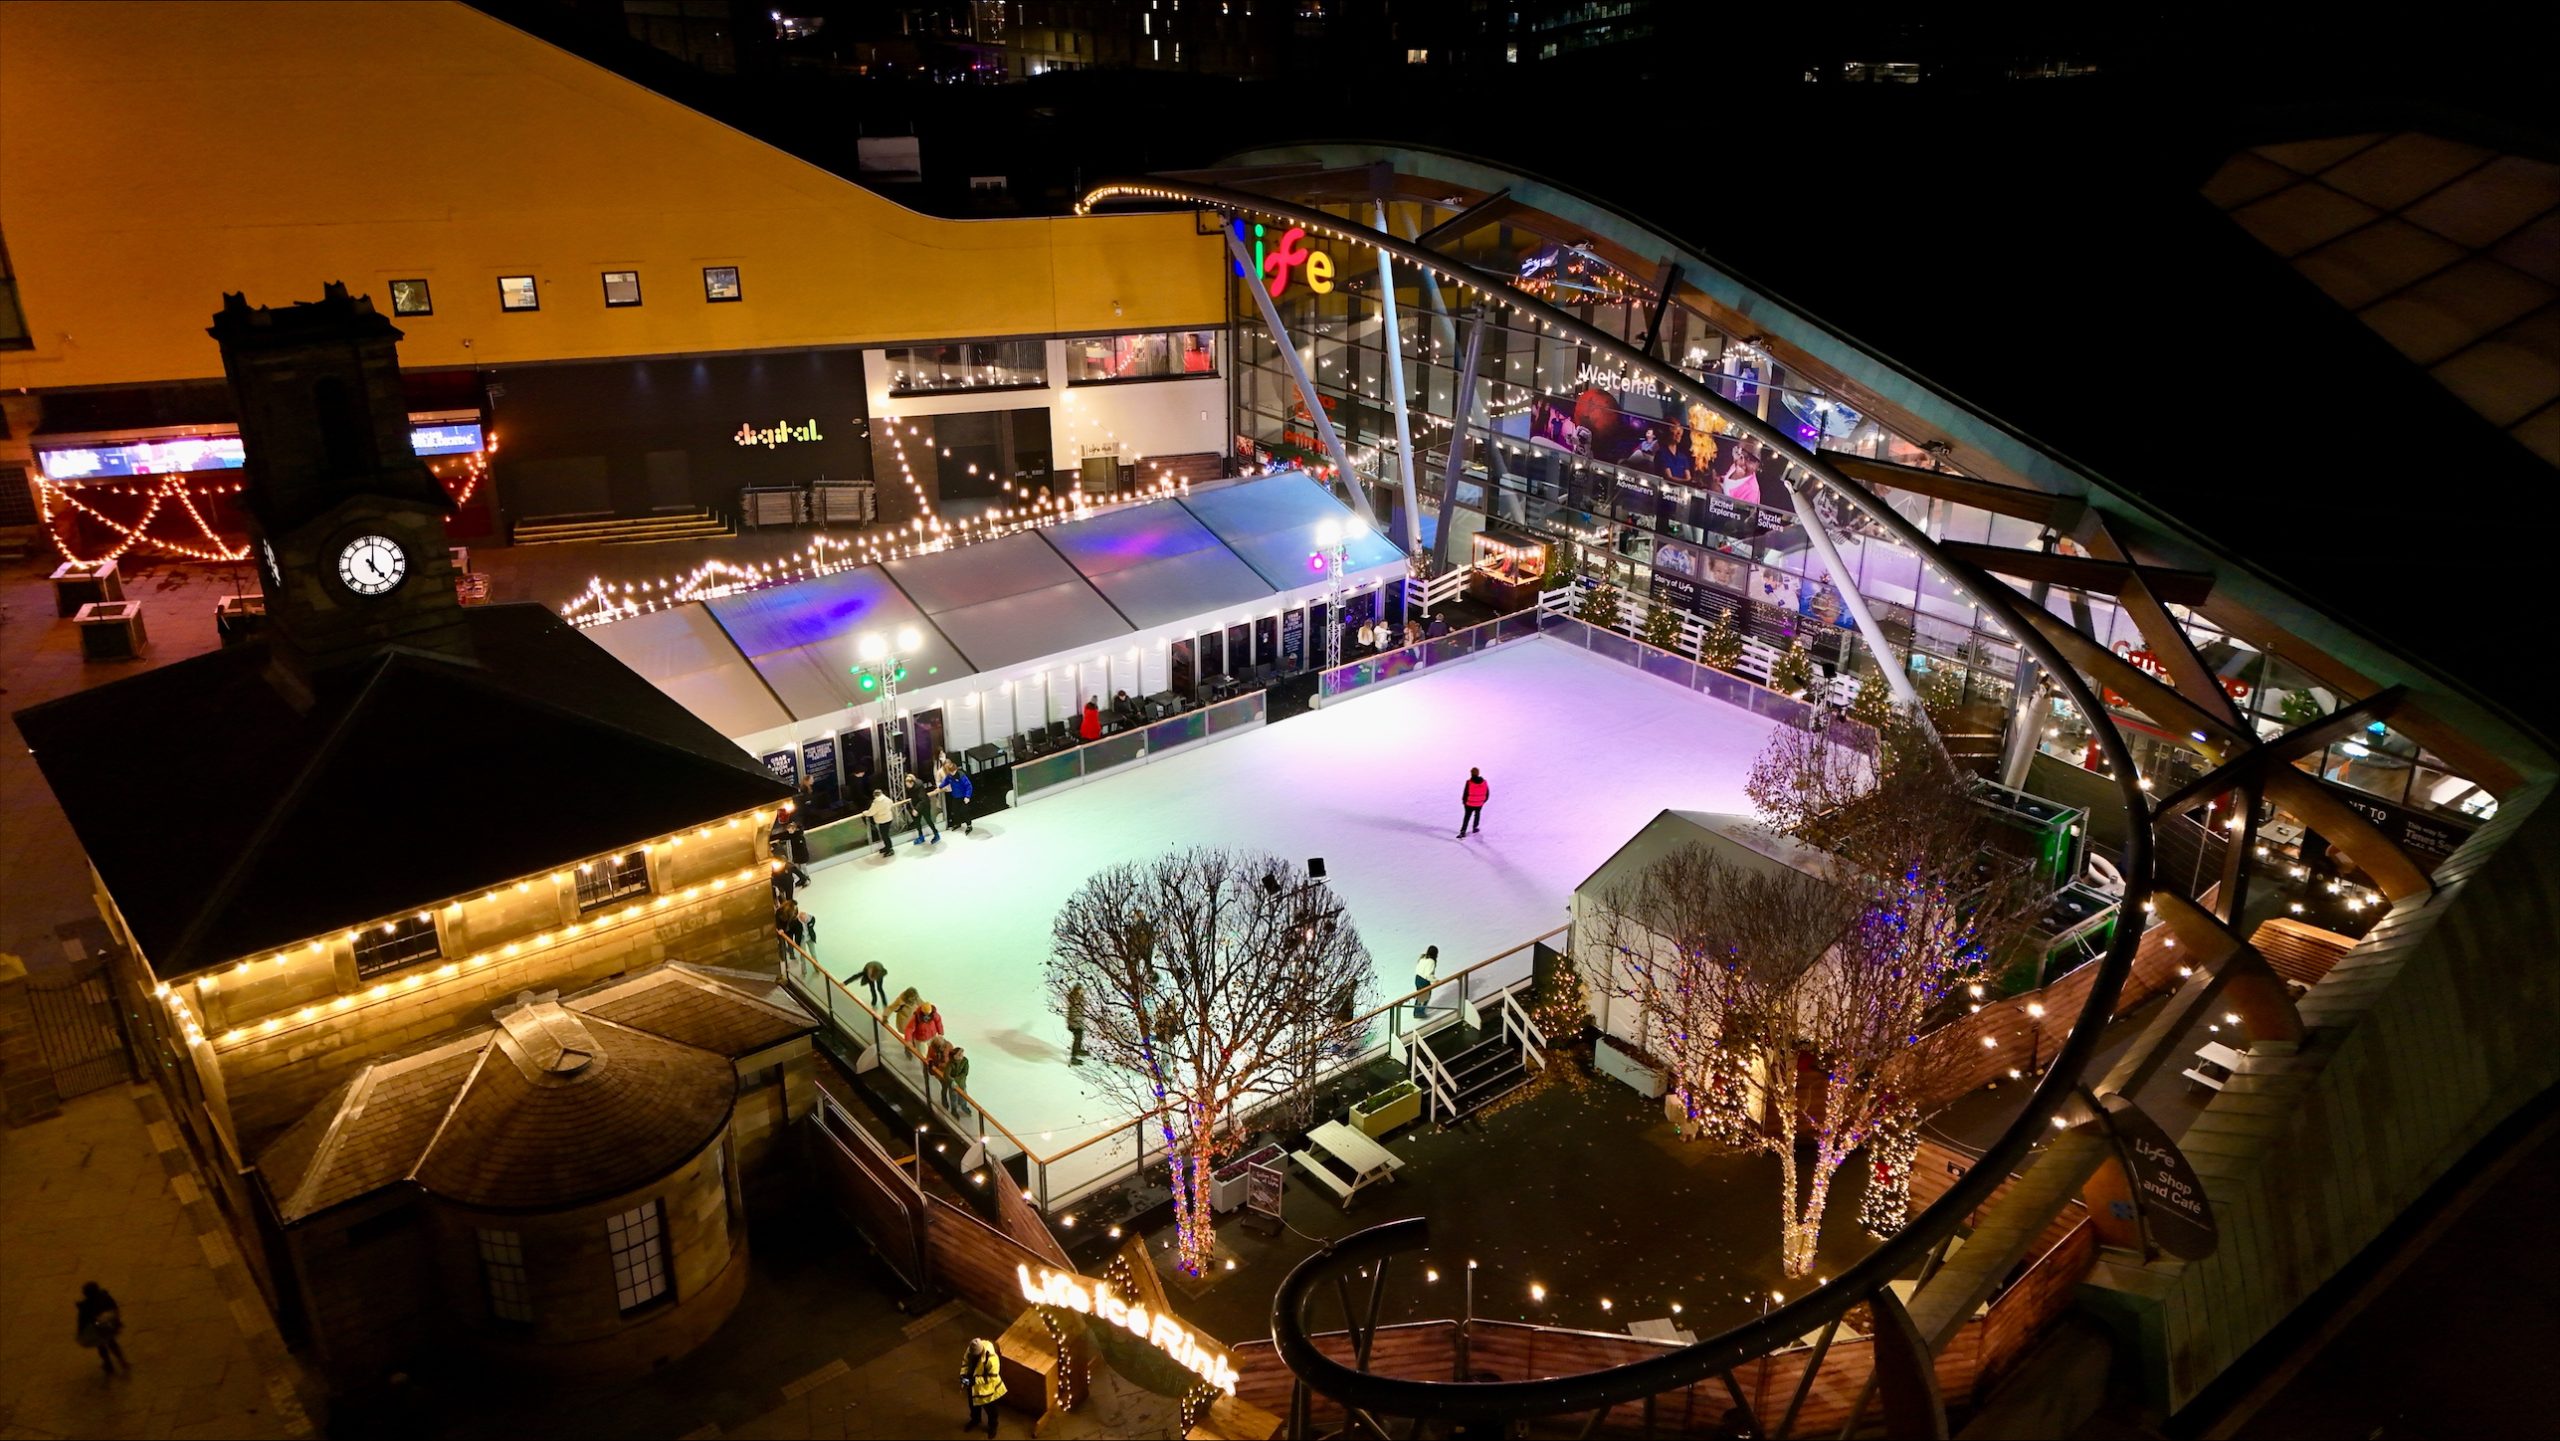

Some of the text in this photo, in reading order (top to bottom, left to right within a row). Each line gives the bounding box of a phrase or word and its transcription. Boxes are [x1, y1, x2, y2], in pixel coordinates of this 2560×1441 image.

[1616, 480, 1654, 497] Adventurers
[1710, 497, 1734, 511] Excited
[1709, 506, 1741, 521] Explorers
[1758, 510, 1781, 524] Puzzle
[1758, 519, 1784, 533] Solvers
[1655, 573, 1670, 586] Story
[2370, 807, 2387, 821] TO
[2405, 828, 2436, 846] Times
[2136, 1138, 2175, 1168] Life
[2159, 1171, 2192, 1195] Shop
[2143, 1180, 2201, 1214] and Café
[1017, 1263, 1240, 1397] Life Ice Rink
